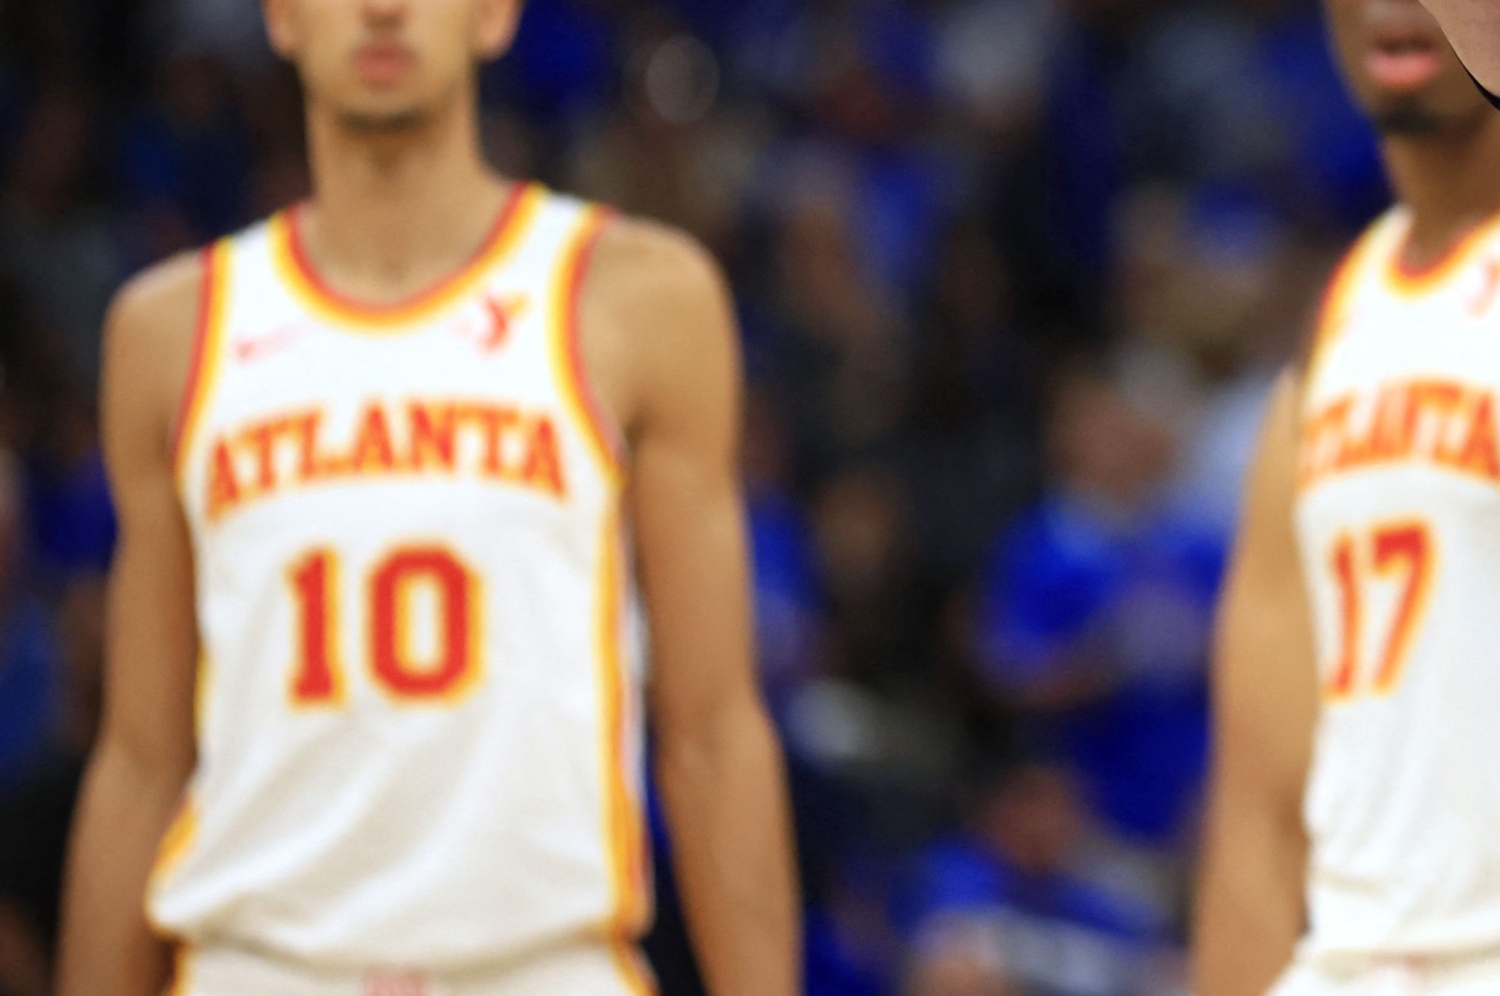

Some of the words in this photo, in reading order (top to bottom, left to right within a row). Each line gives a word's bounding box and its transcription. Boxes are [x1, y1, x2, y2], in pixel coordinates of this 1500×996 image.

[205, 397, 567, 525] ATLANTA
[287, 534, 486, 710] 10
[1320, 520, 1438, 700] 17
